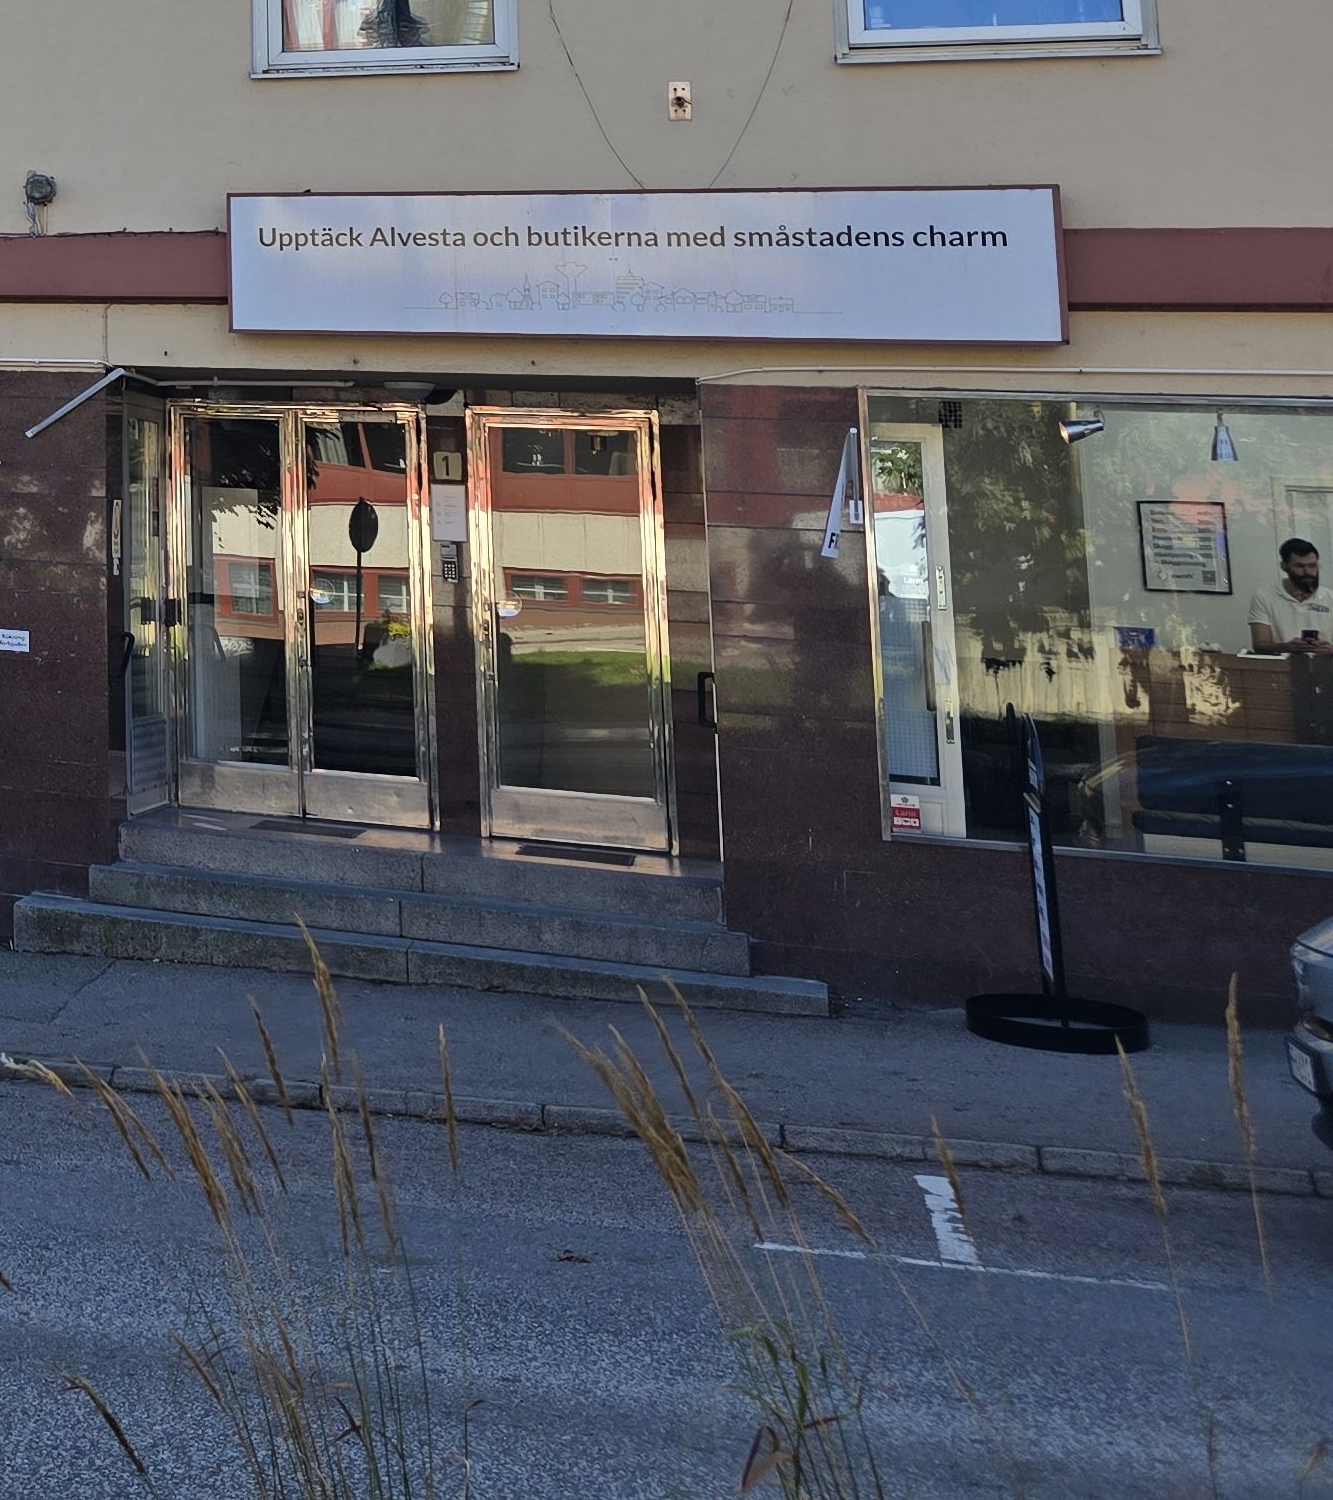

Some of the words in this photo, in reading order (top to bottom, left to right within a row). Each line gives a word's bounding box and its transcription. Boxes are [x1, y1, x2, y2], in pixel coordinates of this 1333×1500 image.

[258, 227, 363, 251] Upptäck
[369, 227, 466, 247] Alvesta
[473, 226, 520, 247] och
[527, 226, 659, 247] butikerna
[666, 226, 726, 247] med
[733, 224, 905, 247] småstadens
[912, 225, 1008, 247] charm
[441, 455, 450, 477] 1
